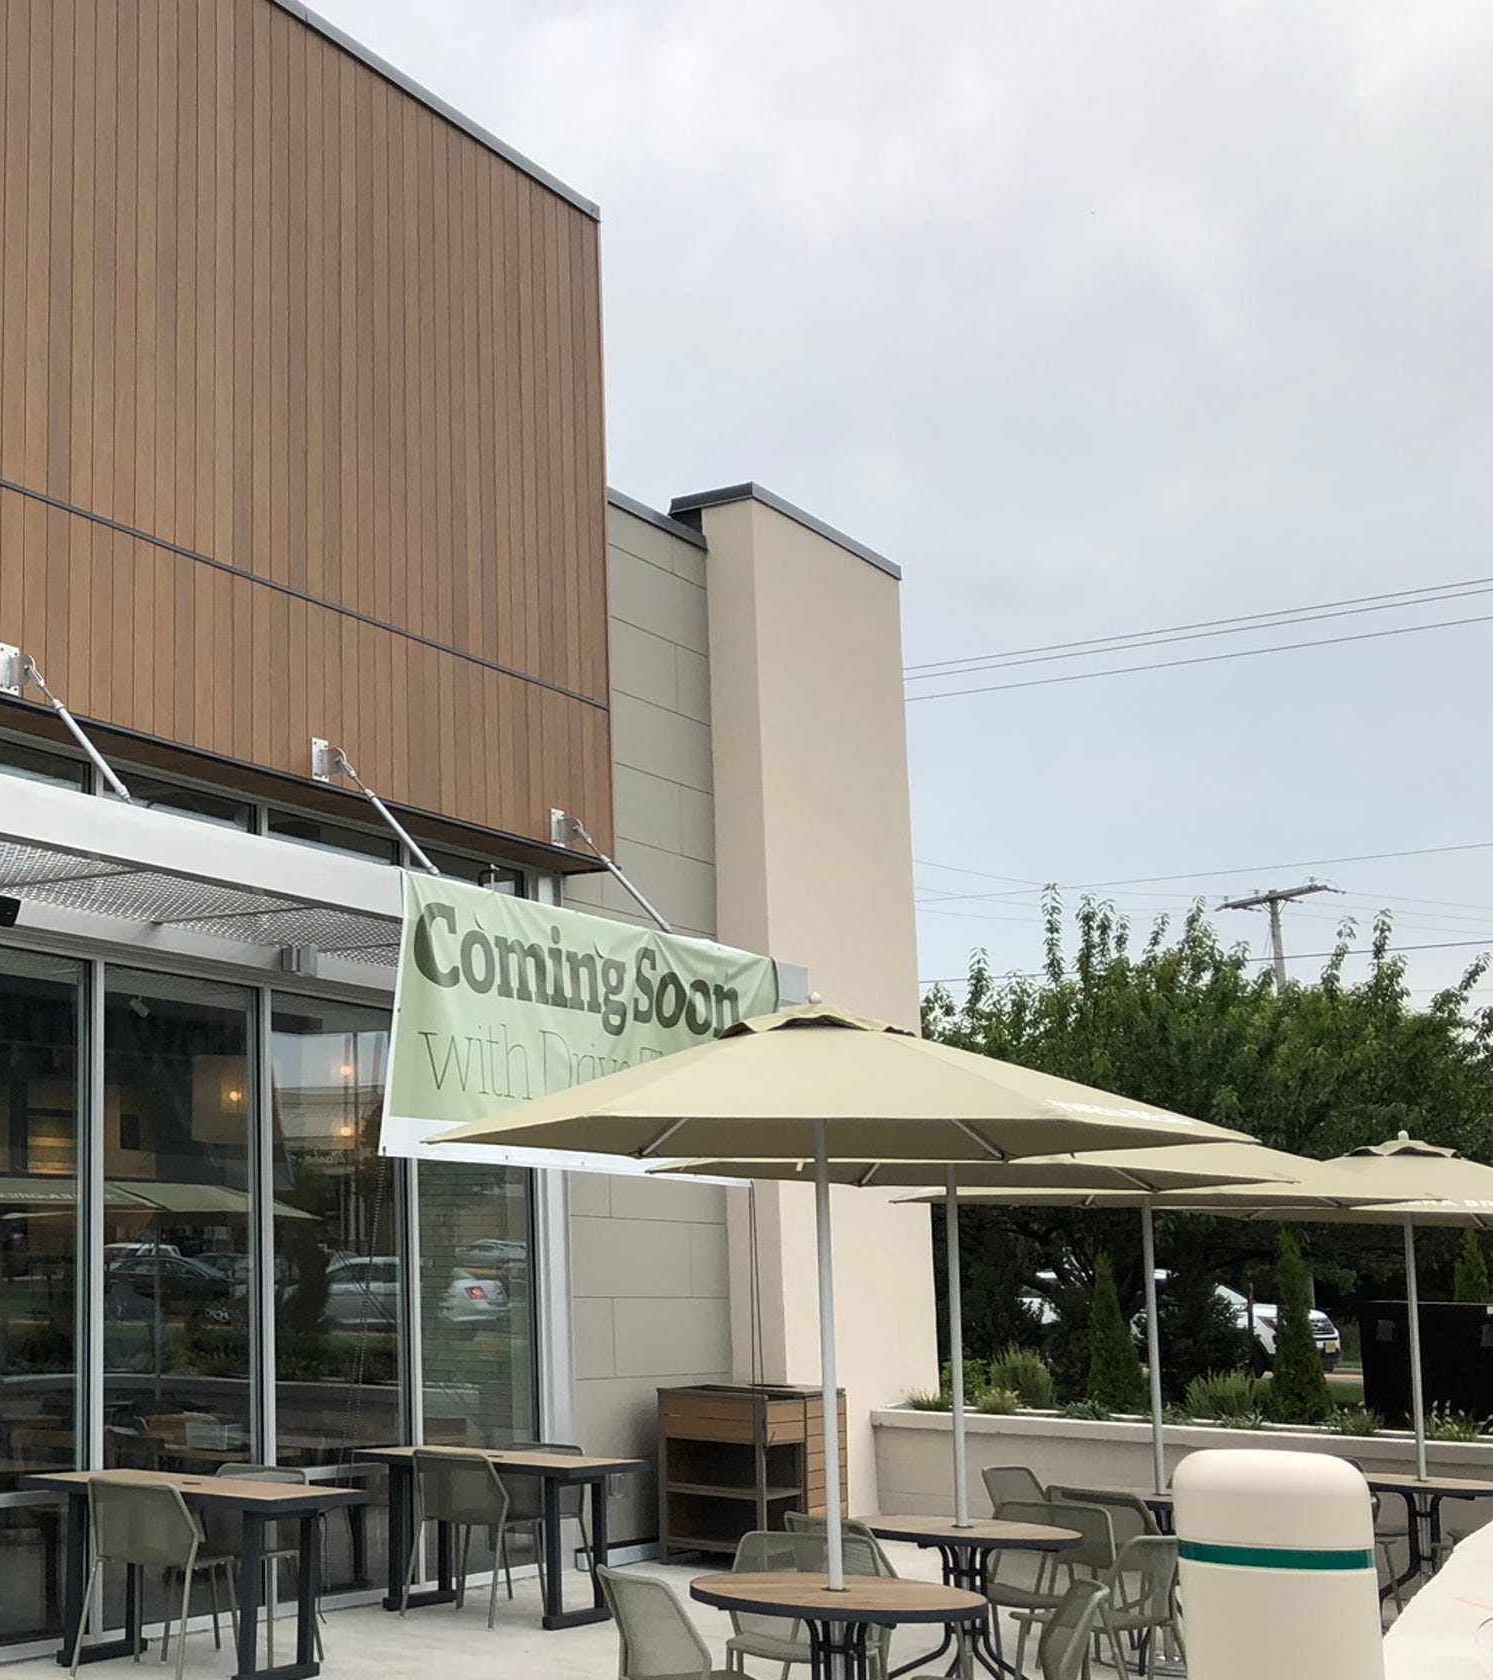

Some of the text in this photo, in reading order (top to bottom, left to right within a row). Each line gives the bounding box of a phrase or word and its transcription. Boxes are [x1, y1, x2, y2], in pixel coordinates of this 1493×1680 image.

[413, 902, 740, 1038] Coming Soon
[418, 1024, 533, 1101] with
